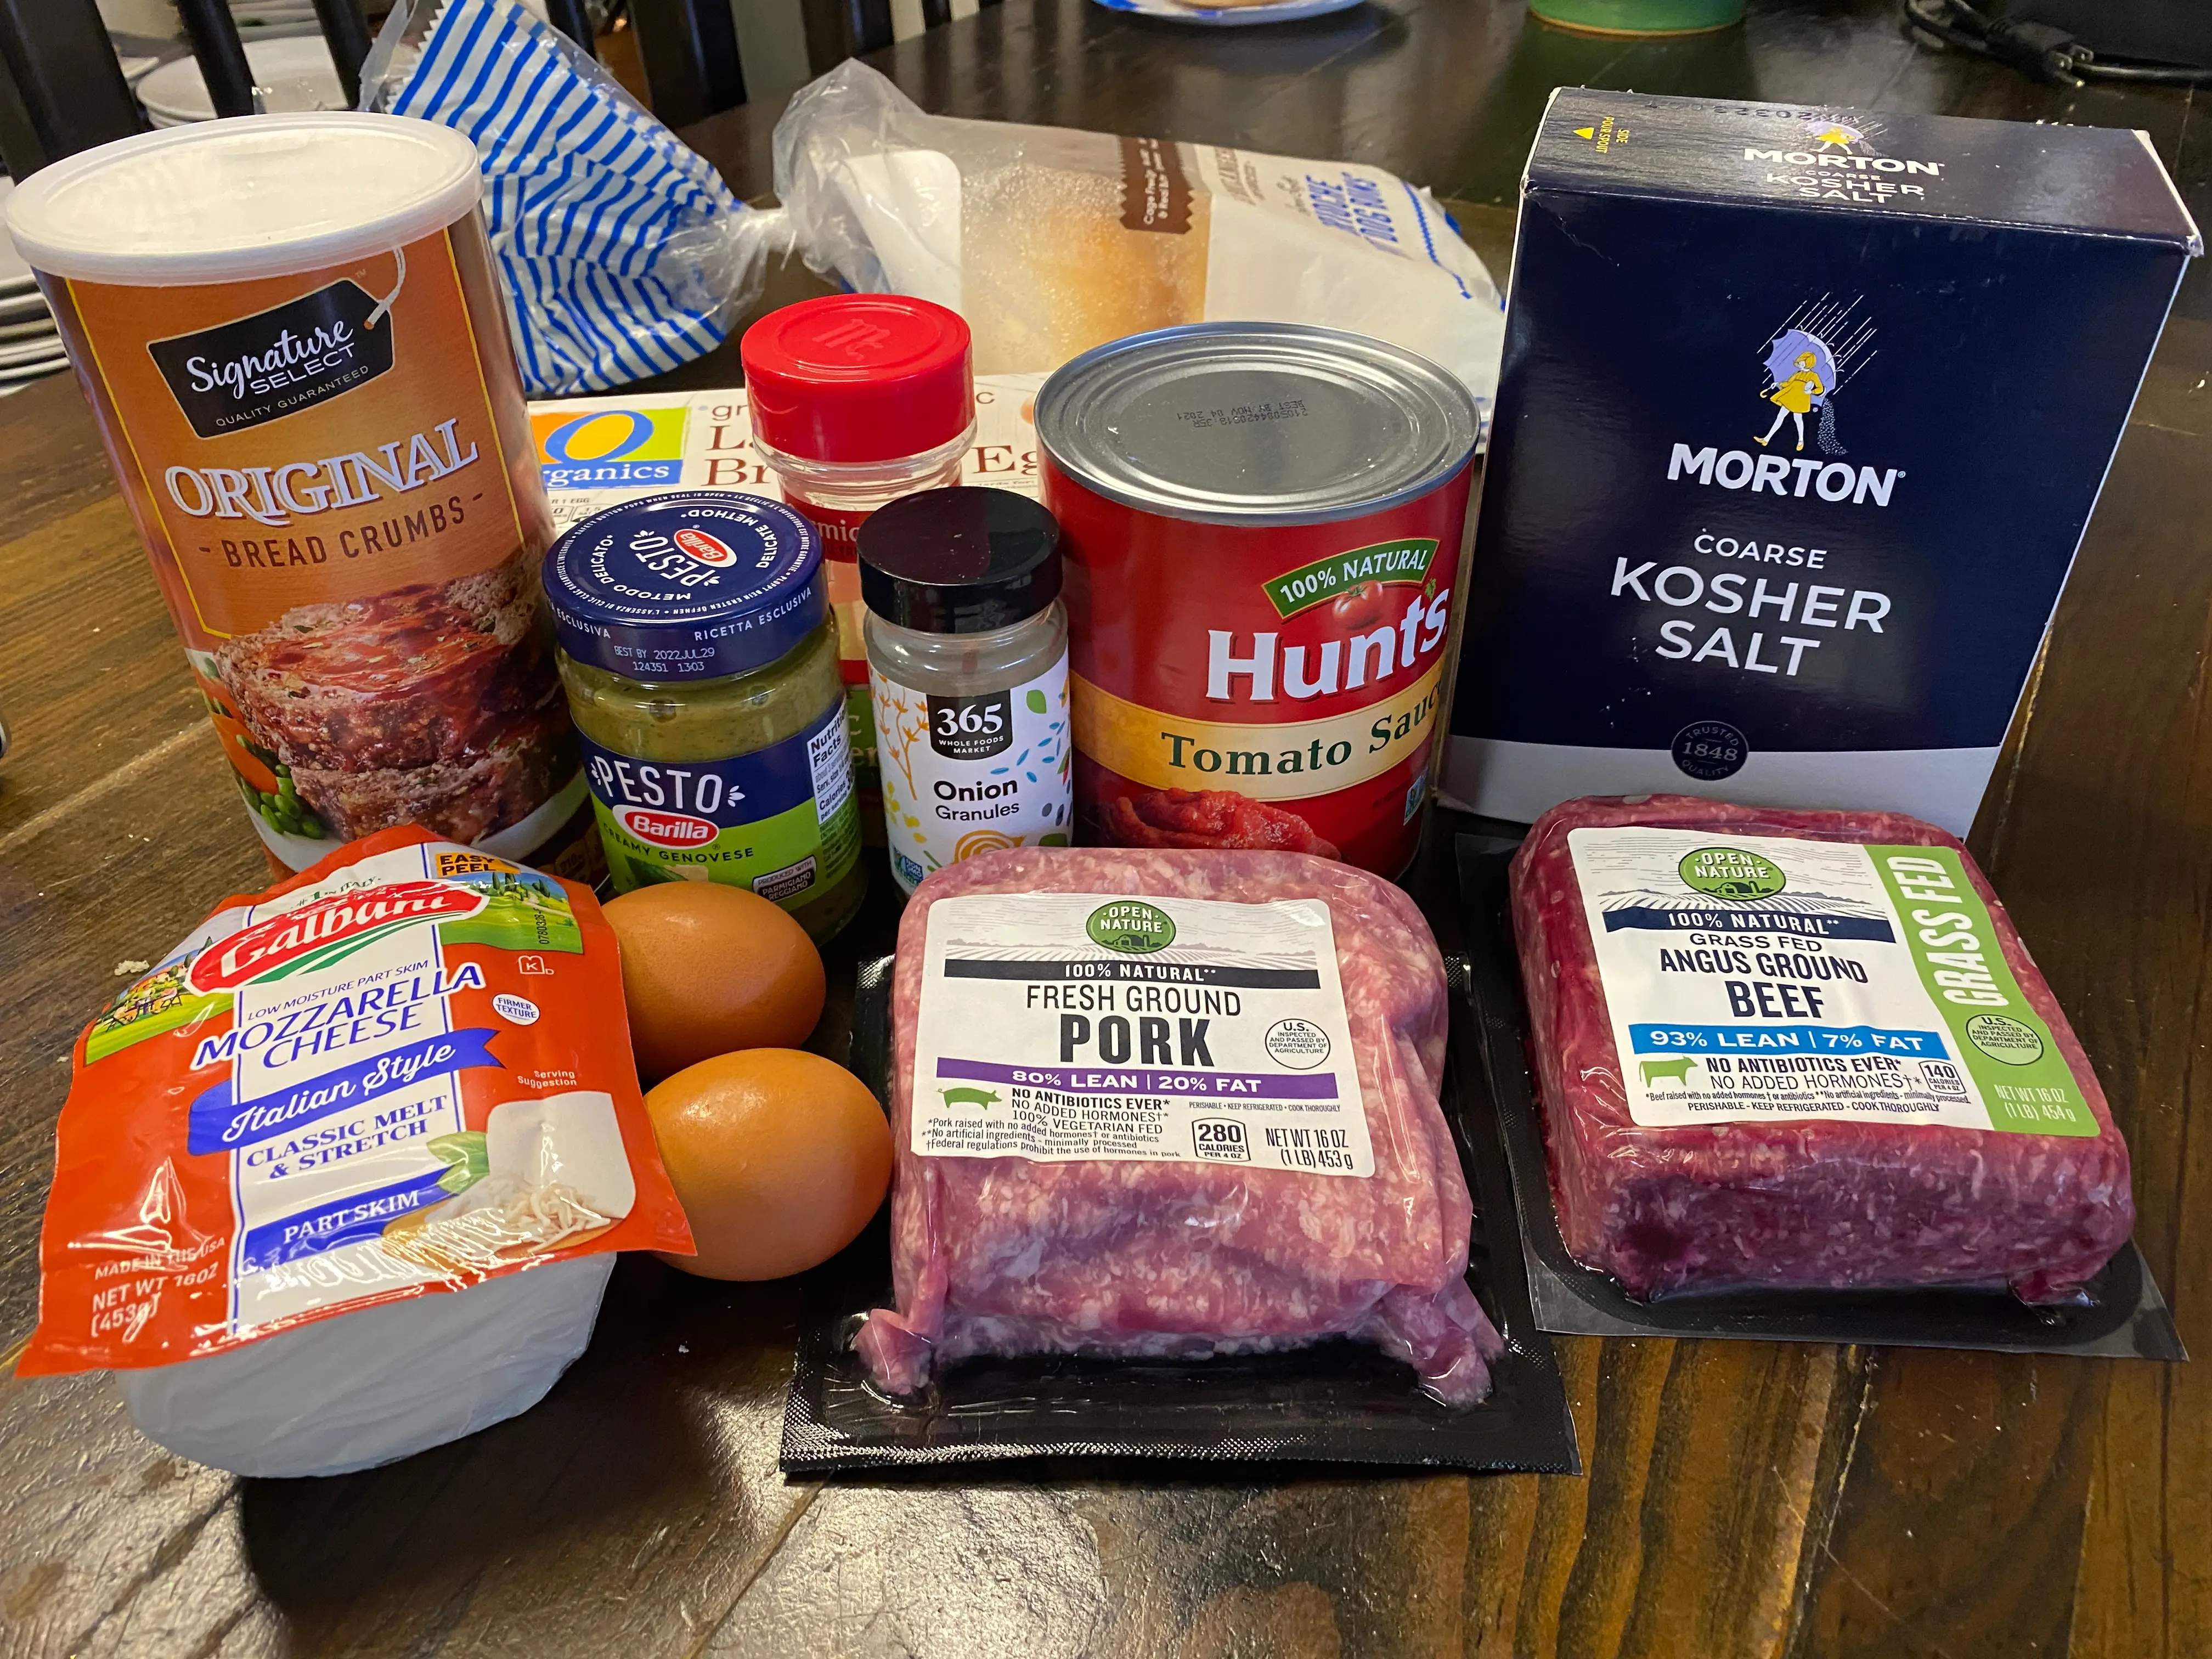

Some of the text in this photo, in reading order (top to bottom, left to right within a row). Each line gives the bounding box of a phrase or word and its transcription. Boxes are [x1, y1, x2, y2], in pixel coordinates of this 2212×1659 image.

[1595, 115, 1615, 154] POUR SPOUT
[1616, 128, 1630, 143] SIDE
[1743, 148, 1940, 176] MORTON
[1767, 173, 1925, 196] KOSHER
[1805, 170, 1881, 182] COARSE
[1799, 187, 1893, 204] SALT
[186, 319, 354, 399] Signature
[250, 342, 355, 396] SELECT
[216, 365, 369, 427] QUALITY GUARANTEED
[165, 417, 479, 527] ORIGINAL
[1667, 443, 1897, 507] MORTON
[574, 521, 597, 535] SAFETY
[595, 507, 623, 521] BUTTON
[624, 501, 644, 509] POPS
[222, 495, 465, 569] BREAD CRUMBS
[680, 532, 725, 560] Barilla
[755, 524, 778, 568] DELICATE
[1694, 533, 1827, 569] COARSE
[629, 536, 715, 588] PESTO
[1279, 549, 1428, 604] 100% NATURAL
[613, 584, 691, 601] METODO
[1611, 556, 1891, 634] KOSHER
[694, 586, 812, 641] RICETTA ESCLUSIVA
[614, 645, 715, 661] BEST BY 2022JUL29
[1655, 620, 1820, 676] SALT
[633, 661, 669, 673] 124351
[937, 703, 1003, 736] 365
[1161, 679, 1440, 775] Tomato Sauc
[974, 735, 1004, 745] FOODS
[1685, 726, 1739, 747] TRUSTED
[814, 734, 842, 768] Facts
[953, 746, 991, 754] MARKET
[1683, 741, 1737, 762] 1848
[1681, 759, 1729, 777] QUALITY
[594, 755, 723, 814] PESTO
[820, 779, 846, 810] Calories
[934, 780, 1018, 802] Onion
[935, 803, 1019, 821] Granules
[633, 815, 709, 840] Barilla
[440, 854, 493, 865] EASY
[659, 847, 754, 863] GENOVESE
[1701, 852, 1754, 867] OPEN
[442, 863, 496, 876] PEEL
[758, 860, 813, 886] PRODUCED WITH
[1694, 865, 1770, 879] NATURE
[761, 872, 811, 895] PARMIGIANO
[769, 880, 809, 901] REGGIANO
[1108, 906, 1153, 919] OPEN
[1668, 912, 1723, 928] 100%
[221, 895, 452, 978] Galbani
[1101, 918, 1163, 933] NATURE
[1887, 856, 2009, 1006] GRASS FED
[1689, 933, 1822, 952] GRASS FED
[1065, 964, 1111, 978] 100%
[1660, 948, 1869, 984] ANGUS GROUND
[248, 960, 428, 1022] LOW MOISTURE PART SKIM
[1026, 984, 1242, 1016] FRESH GROUND
[1724, 980, 1825, 1018] BEEF
[195, 965, 482, 1066] MOZZARELLA
[496, 1004, 537, 1018] TEXTURE
[498, 997, 532, 1011] FIRMER
[263, 1002, 422, 1069] CHEESE
[1284, 1023, 1309, 1031] U.S.
[1060, 1013, 1215, 1067] PORK
[1650, 1030, 1923, 1051] 93% LEAN 7% FAT
[533, 1070, 575, 1080] Serving
[1706, 1057, 1731, 1073] NO
[1738, 1057, 1847, 1073] ANTIBIOTICS
[222, 1043, 456, 1142] Italian Style
[518, 1075, 577, 1088] Suggestion
[1012, 1070, 1262, 1093] 80% LEAN 20% FAT
[1710, 1075, 1798, 1090] NO ADDED
[1012, 1087, 1030, 1098] NO
[1035, 1090, 1122, 1109] ANTIBIOTICS
[1012, 1098, 1077, 1119] NO ADDED
[1688, 1102, 1939, 1113] PERISHABLE KEEP REFRIGERATED COOK THOROUGHLY
[246, 1096, 447, 1168] CLASSIC MELT
[955, 1118, 983, 1128] raised
[986, 1120, 1005, 1129] with
[1021, 1123, 1047, 1136] added
[1012, 1110, 1163, 1134] 100% VEGETARIAN FED
[1198, 1124, 1242, 1143] 280
[297, 1120, 428, 1172] STRETCH
[1199, 1144, 1245, 1153] CALORIES
[1266, 1128, 1349, 1148] NET WT 16 OZ
[283, 1190, 420, 1243] PART SKIM
[93, 1283, 132, 1313] NET
[136, 1276, 168, 1296] WT
